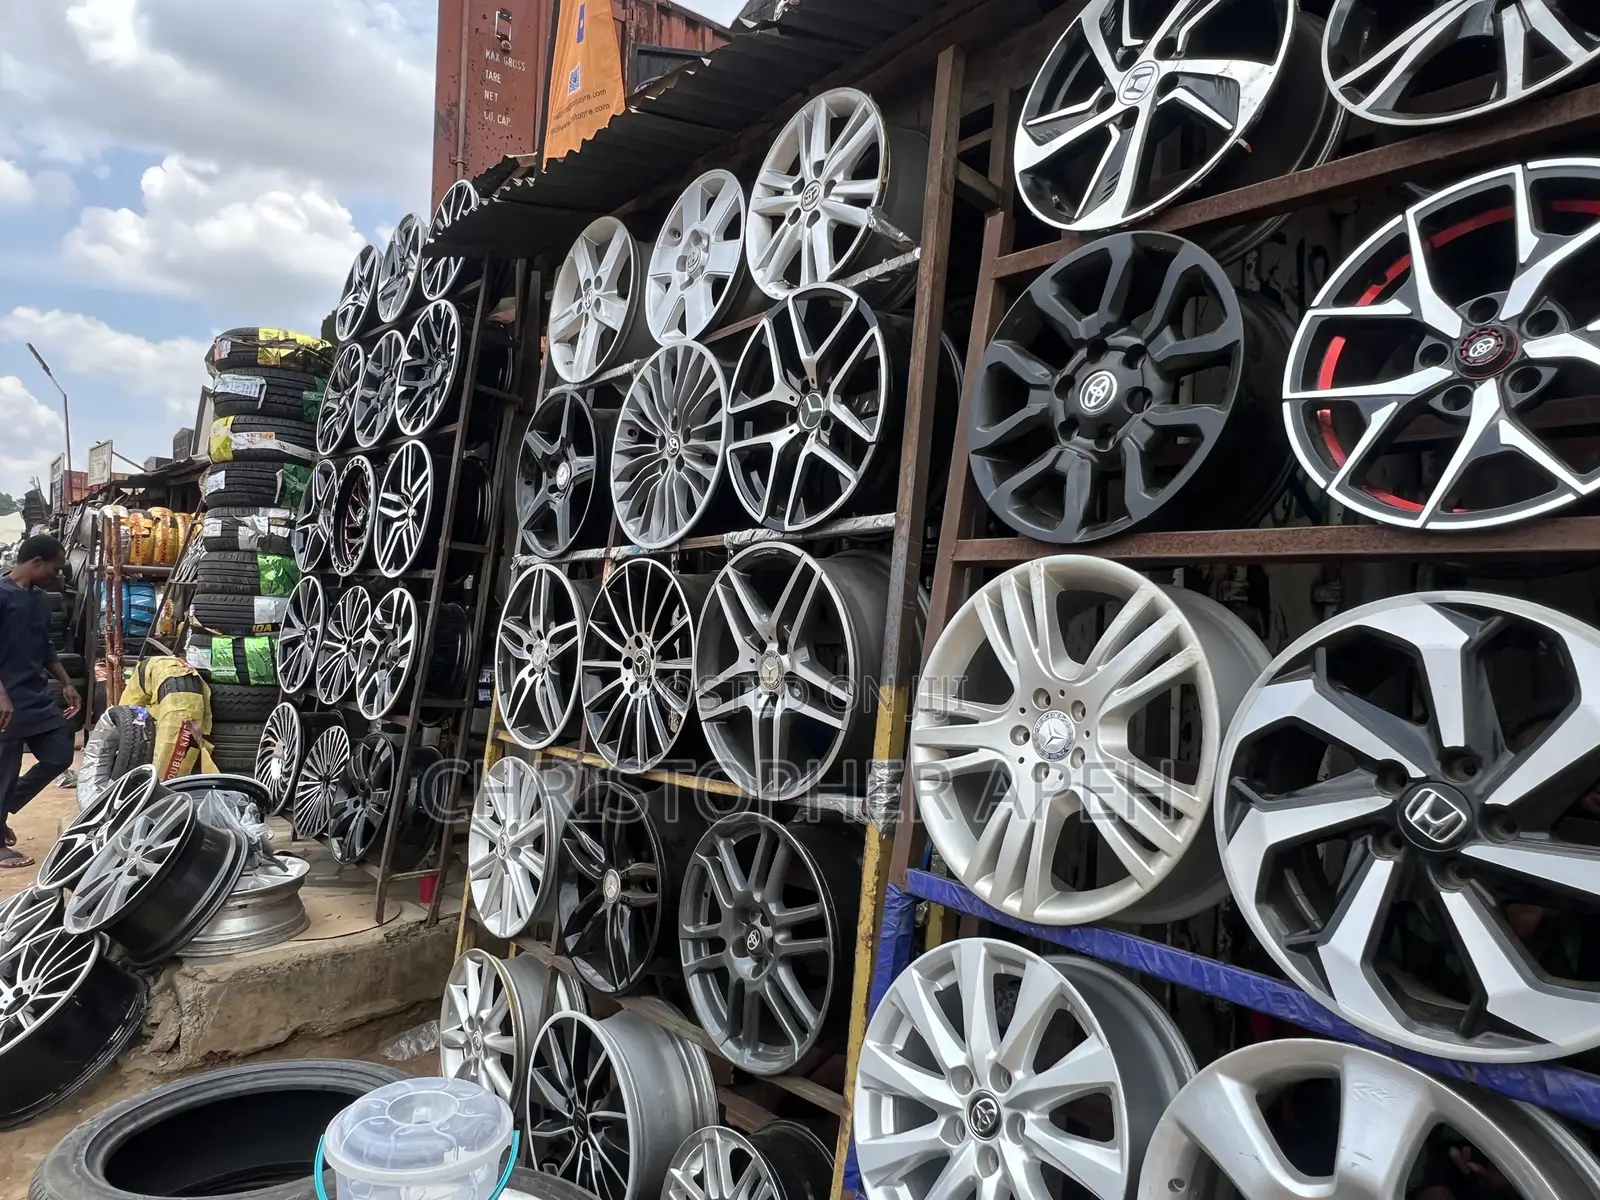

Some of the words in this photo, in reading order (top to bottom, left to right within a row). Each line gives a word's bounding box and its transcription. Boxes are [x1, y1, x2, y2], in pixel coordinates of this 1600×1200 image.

[503, 56, 526, 72] GROSS
[485, 69, 502, 84] TARE
[484, 89, 499, 103] NET
